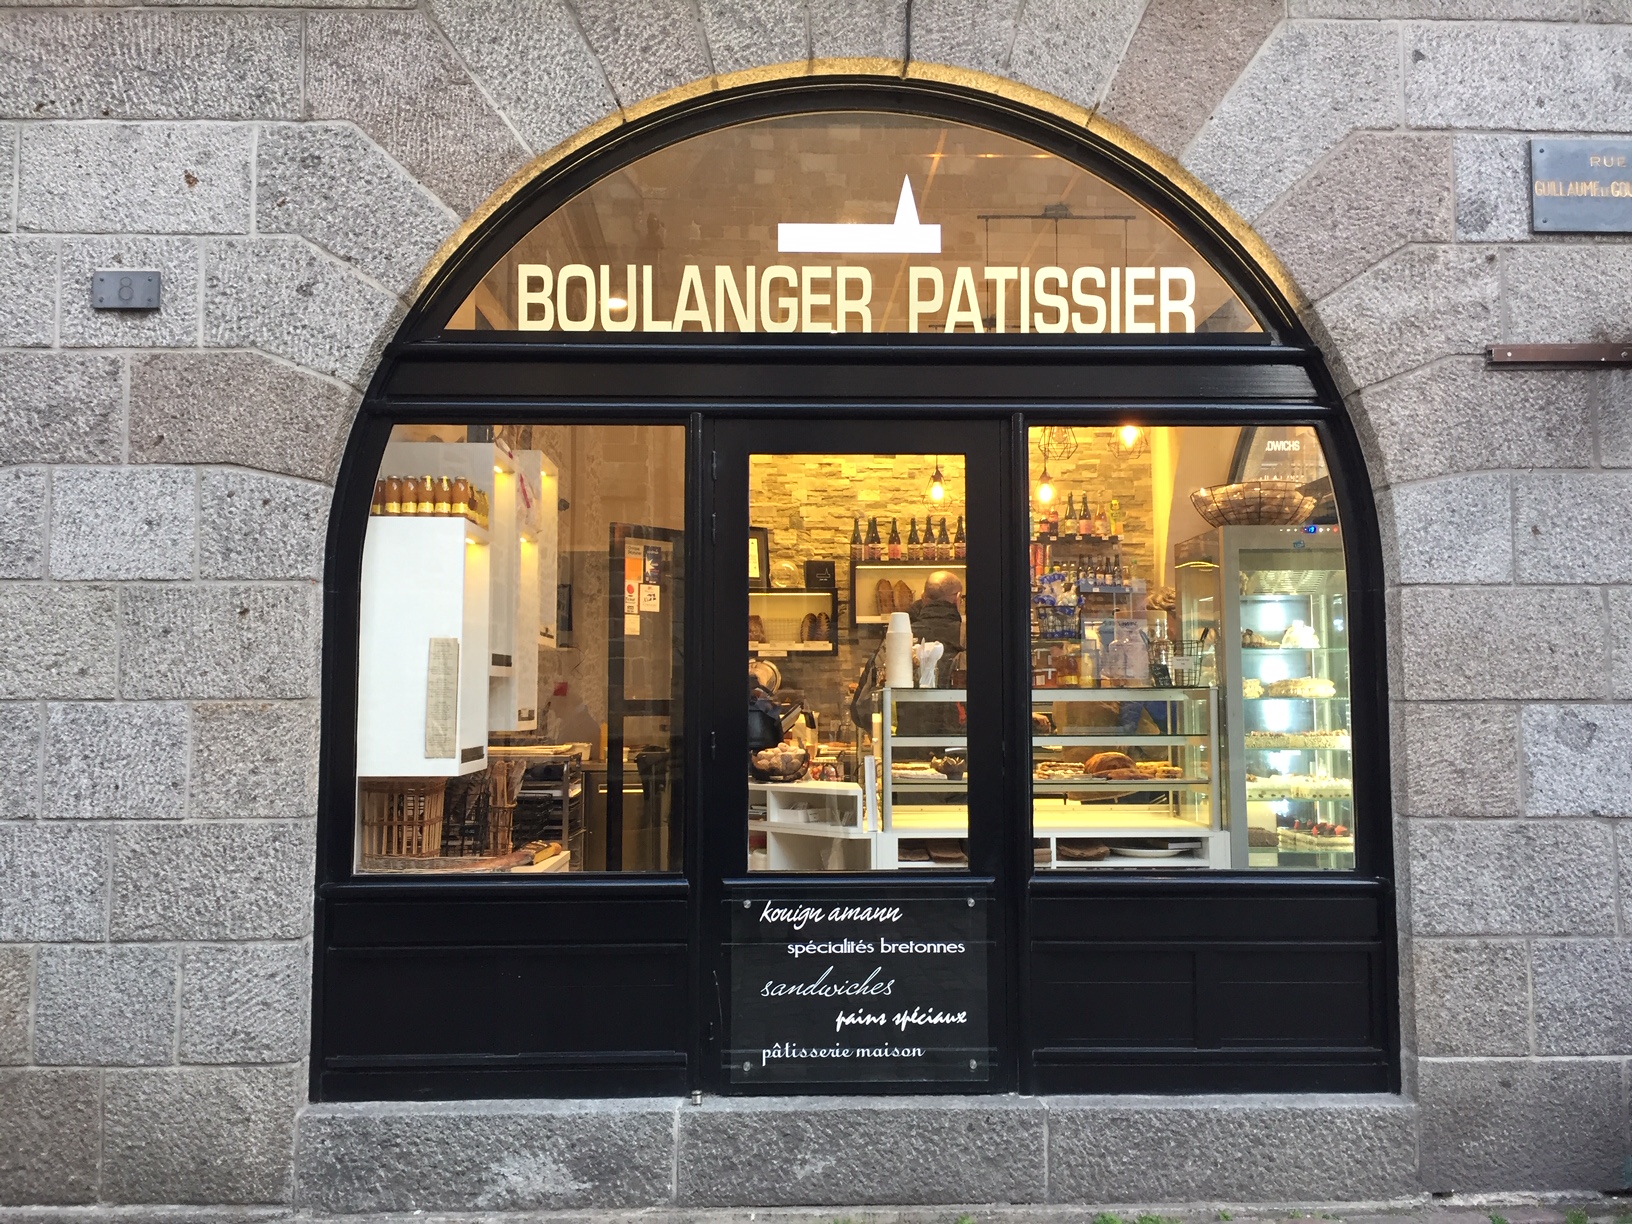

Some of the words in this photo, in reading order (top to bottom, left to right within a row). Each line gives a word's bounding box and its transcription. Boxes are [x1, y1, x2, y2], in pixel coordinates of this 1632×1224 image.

[1589, 156, 1627, 168] RUE
[1534, 180, 1600, 197] GUILLAUME
[118, 276, 134, 301] 8
[517, 263, 873, 333] BOULANGER
[908, 266, 1196, 334] PATISSIER
[1265, 440, 1300, 452] DWICHS
[760, 900, 825, 930] kouign
[828, 906, 903, 922] amann
[786, 938, 875, 958] spécialités
[880, 937, 967, 954] bretonnes
[761, 966, 895, 997] sandwiches
[836, 1008, 887, 1032] pains
[892, 1006, 967, 1031] spéciaux
[762, 1042, 853, 1066] pâtisserie
[856, 1041, 927, 1058] maison
